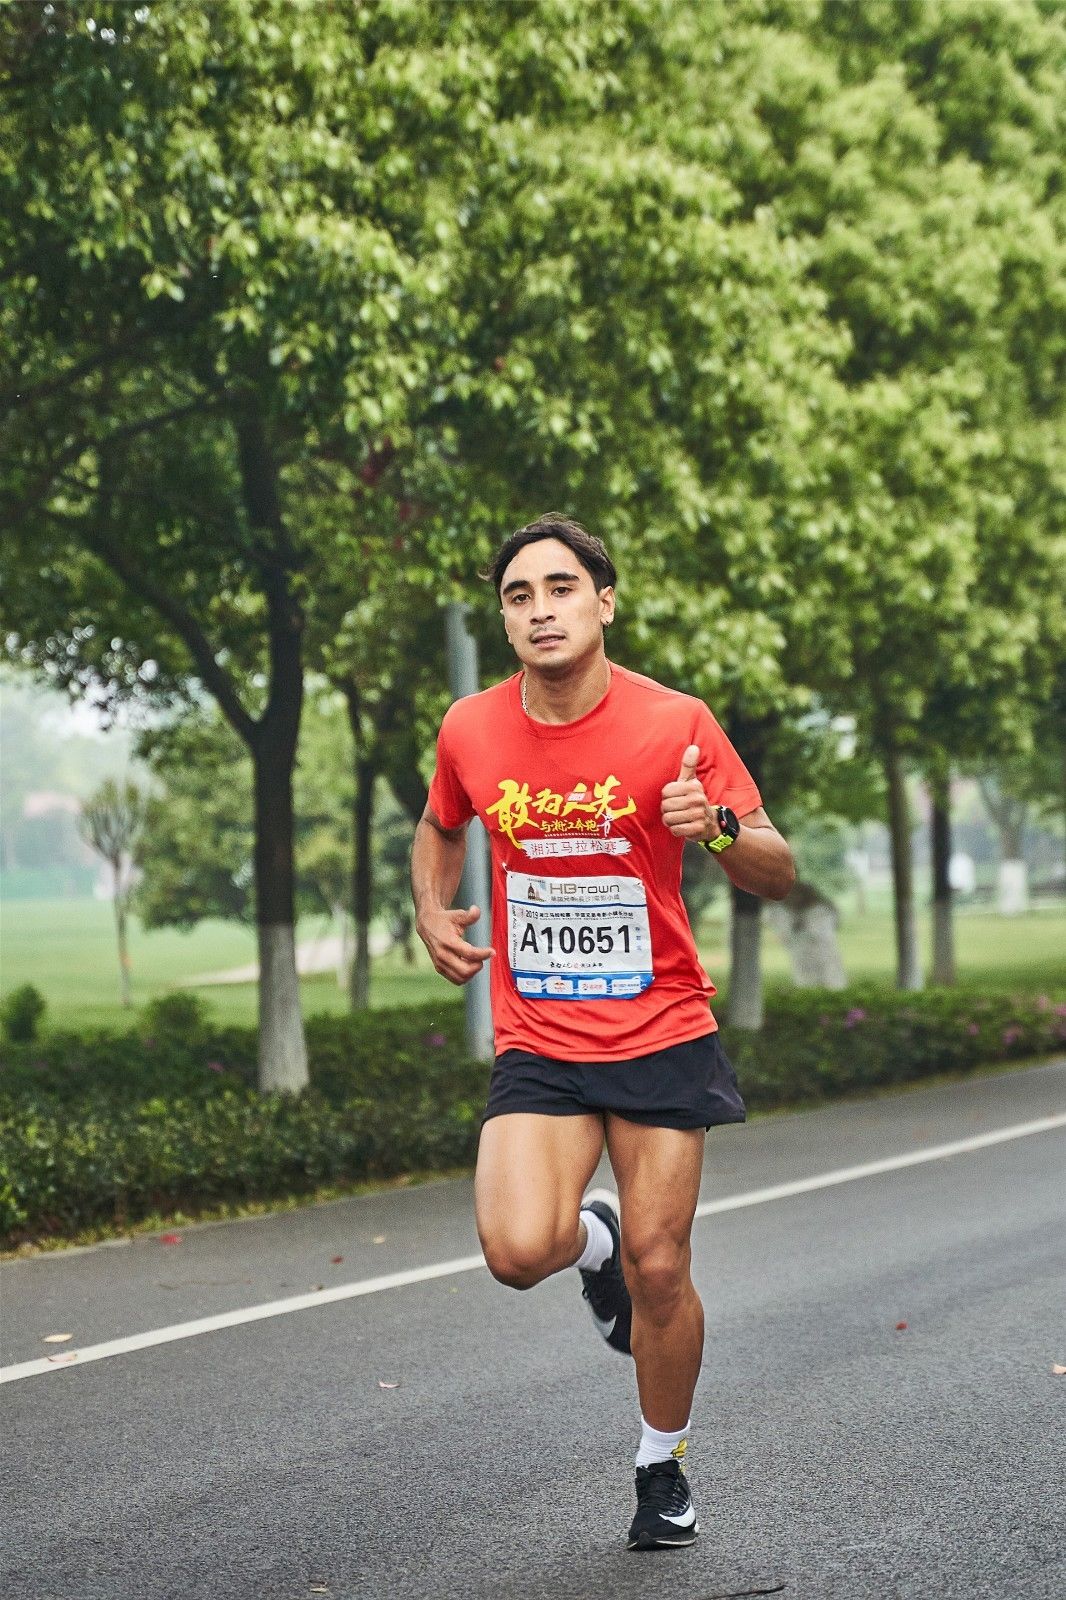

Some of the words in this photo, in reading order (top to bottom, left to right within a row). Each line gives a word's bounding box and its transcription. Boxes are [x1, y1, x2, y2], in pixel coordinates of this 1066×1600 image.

[530, 840, 618, 856] 湘江马拉松赛
[520, 923, 631, 954] A10651
